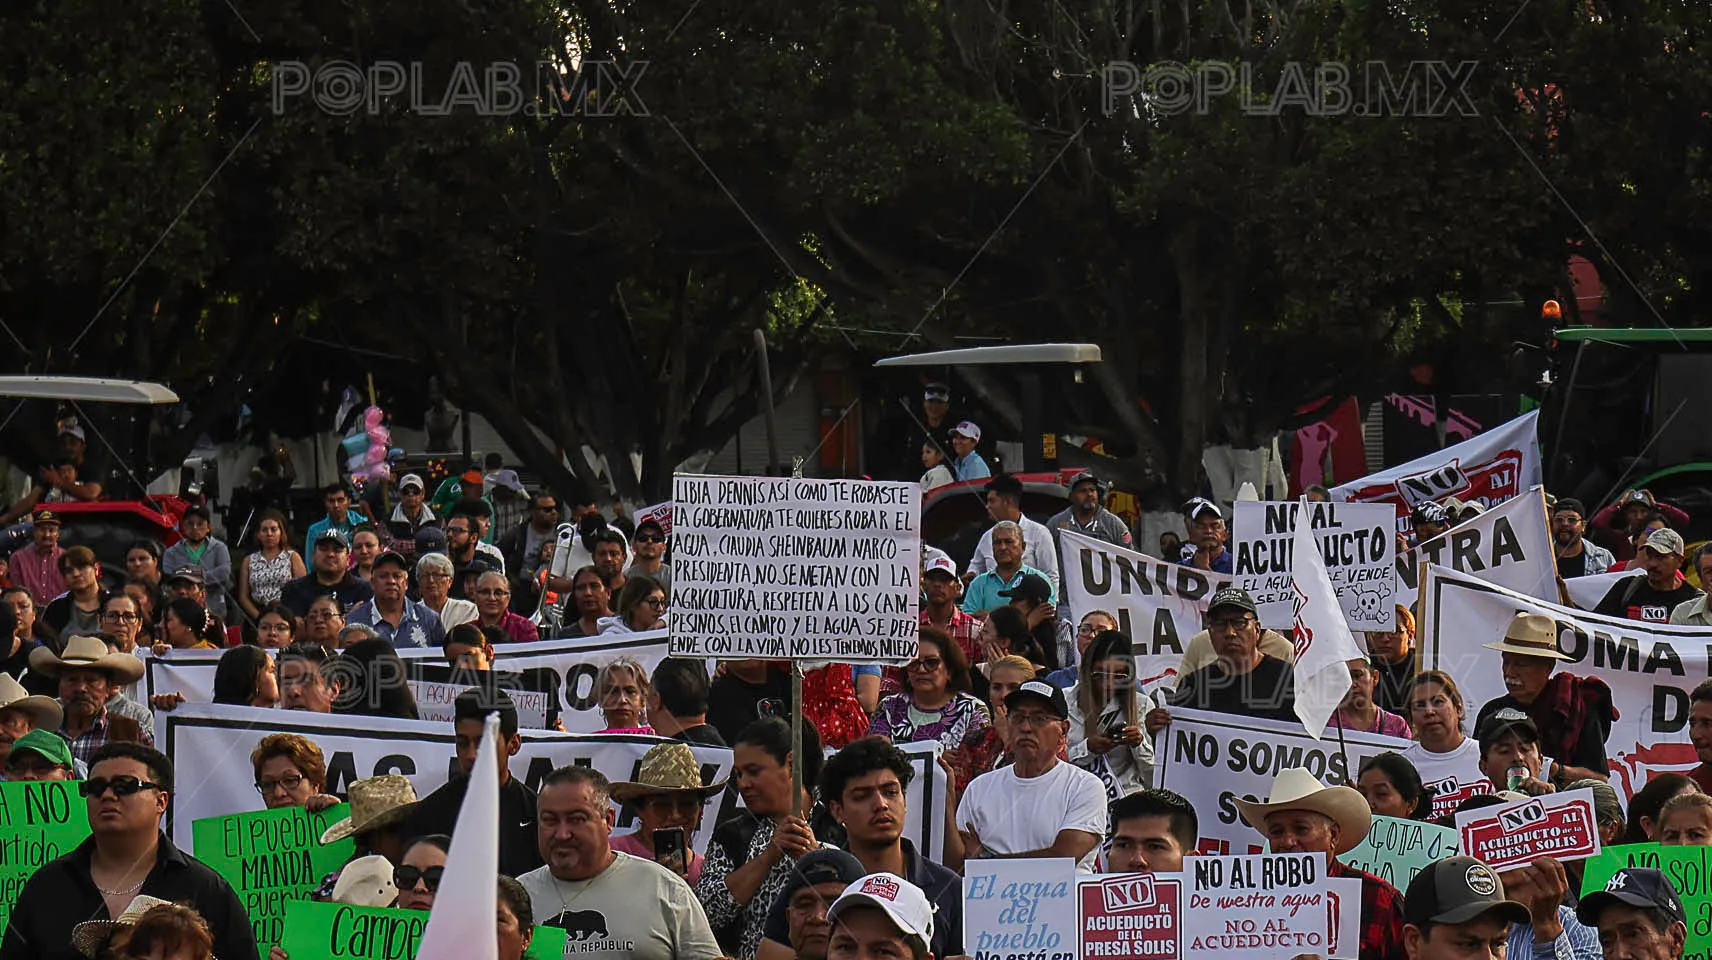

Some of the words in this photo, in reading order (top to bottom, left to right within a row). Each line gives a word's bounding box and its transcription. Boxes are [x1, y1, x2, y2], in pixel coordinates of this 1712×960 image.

[676, 480, 711, 504] LIBIA
[719, 480, 765, 504] DENNIS
[795, 483, 827, 501] COMO
[829, 482, 848, 501] TE
[852, 484, 909, 504] ROBASTE
[1401, 467, 1459, 502] NO
[1490, 469, 1512, 489] AL
[674, 506, 688, 527] LA
[693, 508, 774, 530] GOBERNATURA
[779, 508, 793, 528] TE
[796, 510, 844, 530] QUIERES
[845, 511, 888, 530] ROBAR
[896, 512, 912, 531] EL
[1311, 503, 1342, 529] AL
[769, 536, 846, 559] SHEINBAUM
[1235, 526, 1386, 576] ACUUCTO
[757, 564, 776, 585] NO
[778, 564, 796, 586] SE
[800, 564, 848, 587] METAN
[852, 564, 879, 587] CON
[891, 564, 911, 587] LA
[1243, 579, 1258, 591] EL
[764, 592, 824, 610] RESPETEN
[828, 592, 838, 611] A
[845, 593, 869, 612] LOS
[1645, 609, 1664, 618] NO
[745, 614, 786, 635] CAMPO
[791, 616, 800, 635] Y
[806, 617, 820, 634] EL
[824, 616, 861, 635] AGUA
[867, 618, 885, 635] SE
[670, 636, 700, 652] ENDE
[705, 636, 732, 652] CON
[738, 638, 754, 651] LA
[758, 637, 782, 654] VIDA
[790, 638, 810, 656] NO
[813, 639, 830, 656] LES
[834, 640, 876, 656] TENEMOS
[880, 640, 918, 657] MIEDO
[1555, 619, 1686, 679] OMA
[1174, 729, 1218, 768] NO
[25, 783, 70, 825] NO
[1502, 804, 1542, 831] NO
[1561, 812, 1581, 824] AL
[1478, 827, 1561, 851] ACUEDUCTO
[1485, 845, 1532, 862] PRESA
[1536, 836, 1578, 851] SOLIS
[241, 850, 314, 890] MANDA
[1195, 859, 1223, 891] NO
[1229, 858, 1256, 889] AL
[1262, 855, 1315, 890] ROBO
[967, 874, 997, 900] El
[1000, 881, 1068, 907] agua
[1108, 877, 1149, 907] NO
[999, 900, 1037, 924] del
[1159, 903, 1170, 913] AL
[1189, 893, 1210, 909] De
[1216, 892, 1275, 909] nuestra
[1281, 892, 1322, 917] agua
[1086, 915, 1172, 931] ACUEDUCTO
[1118, 930, 1130, 940] DE
[1132, 930, 1142, 940] LA
[1225, 920, 1255, 934] NO
[1263, 919, 1288, 932] AL
[581, 942, 633, 952] REPUBLIC
[976, 925, 1061, 951] pueblo
[1085, 941, 1133, 956] PRESA
[1134, 940, 1175, 955] SOLIS
[1190, 932, 1322, 950] ACUEDUCTO
